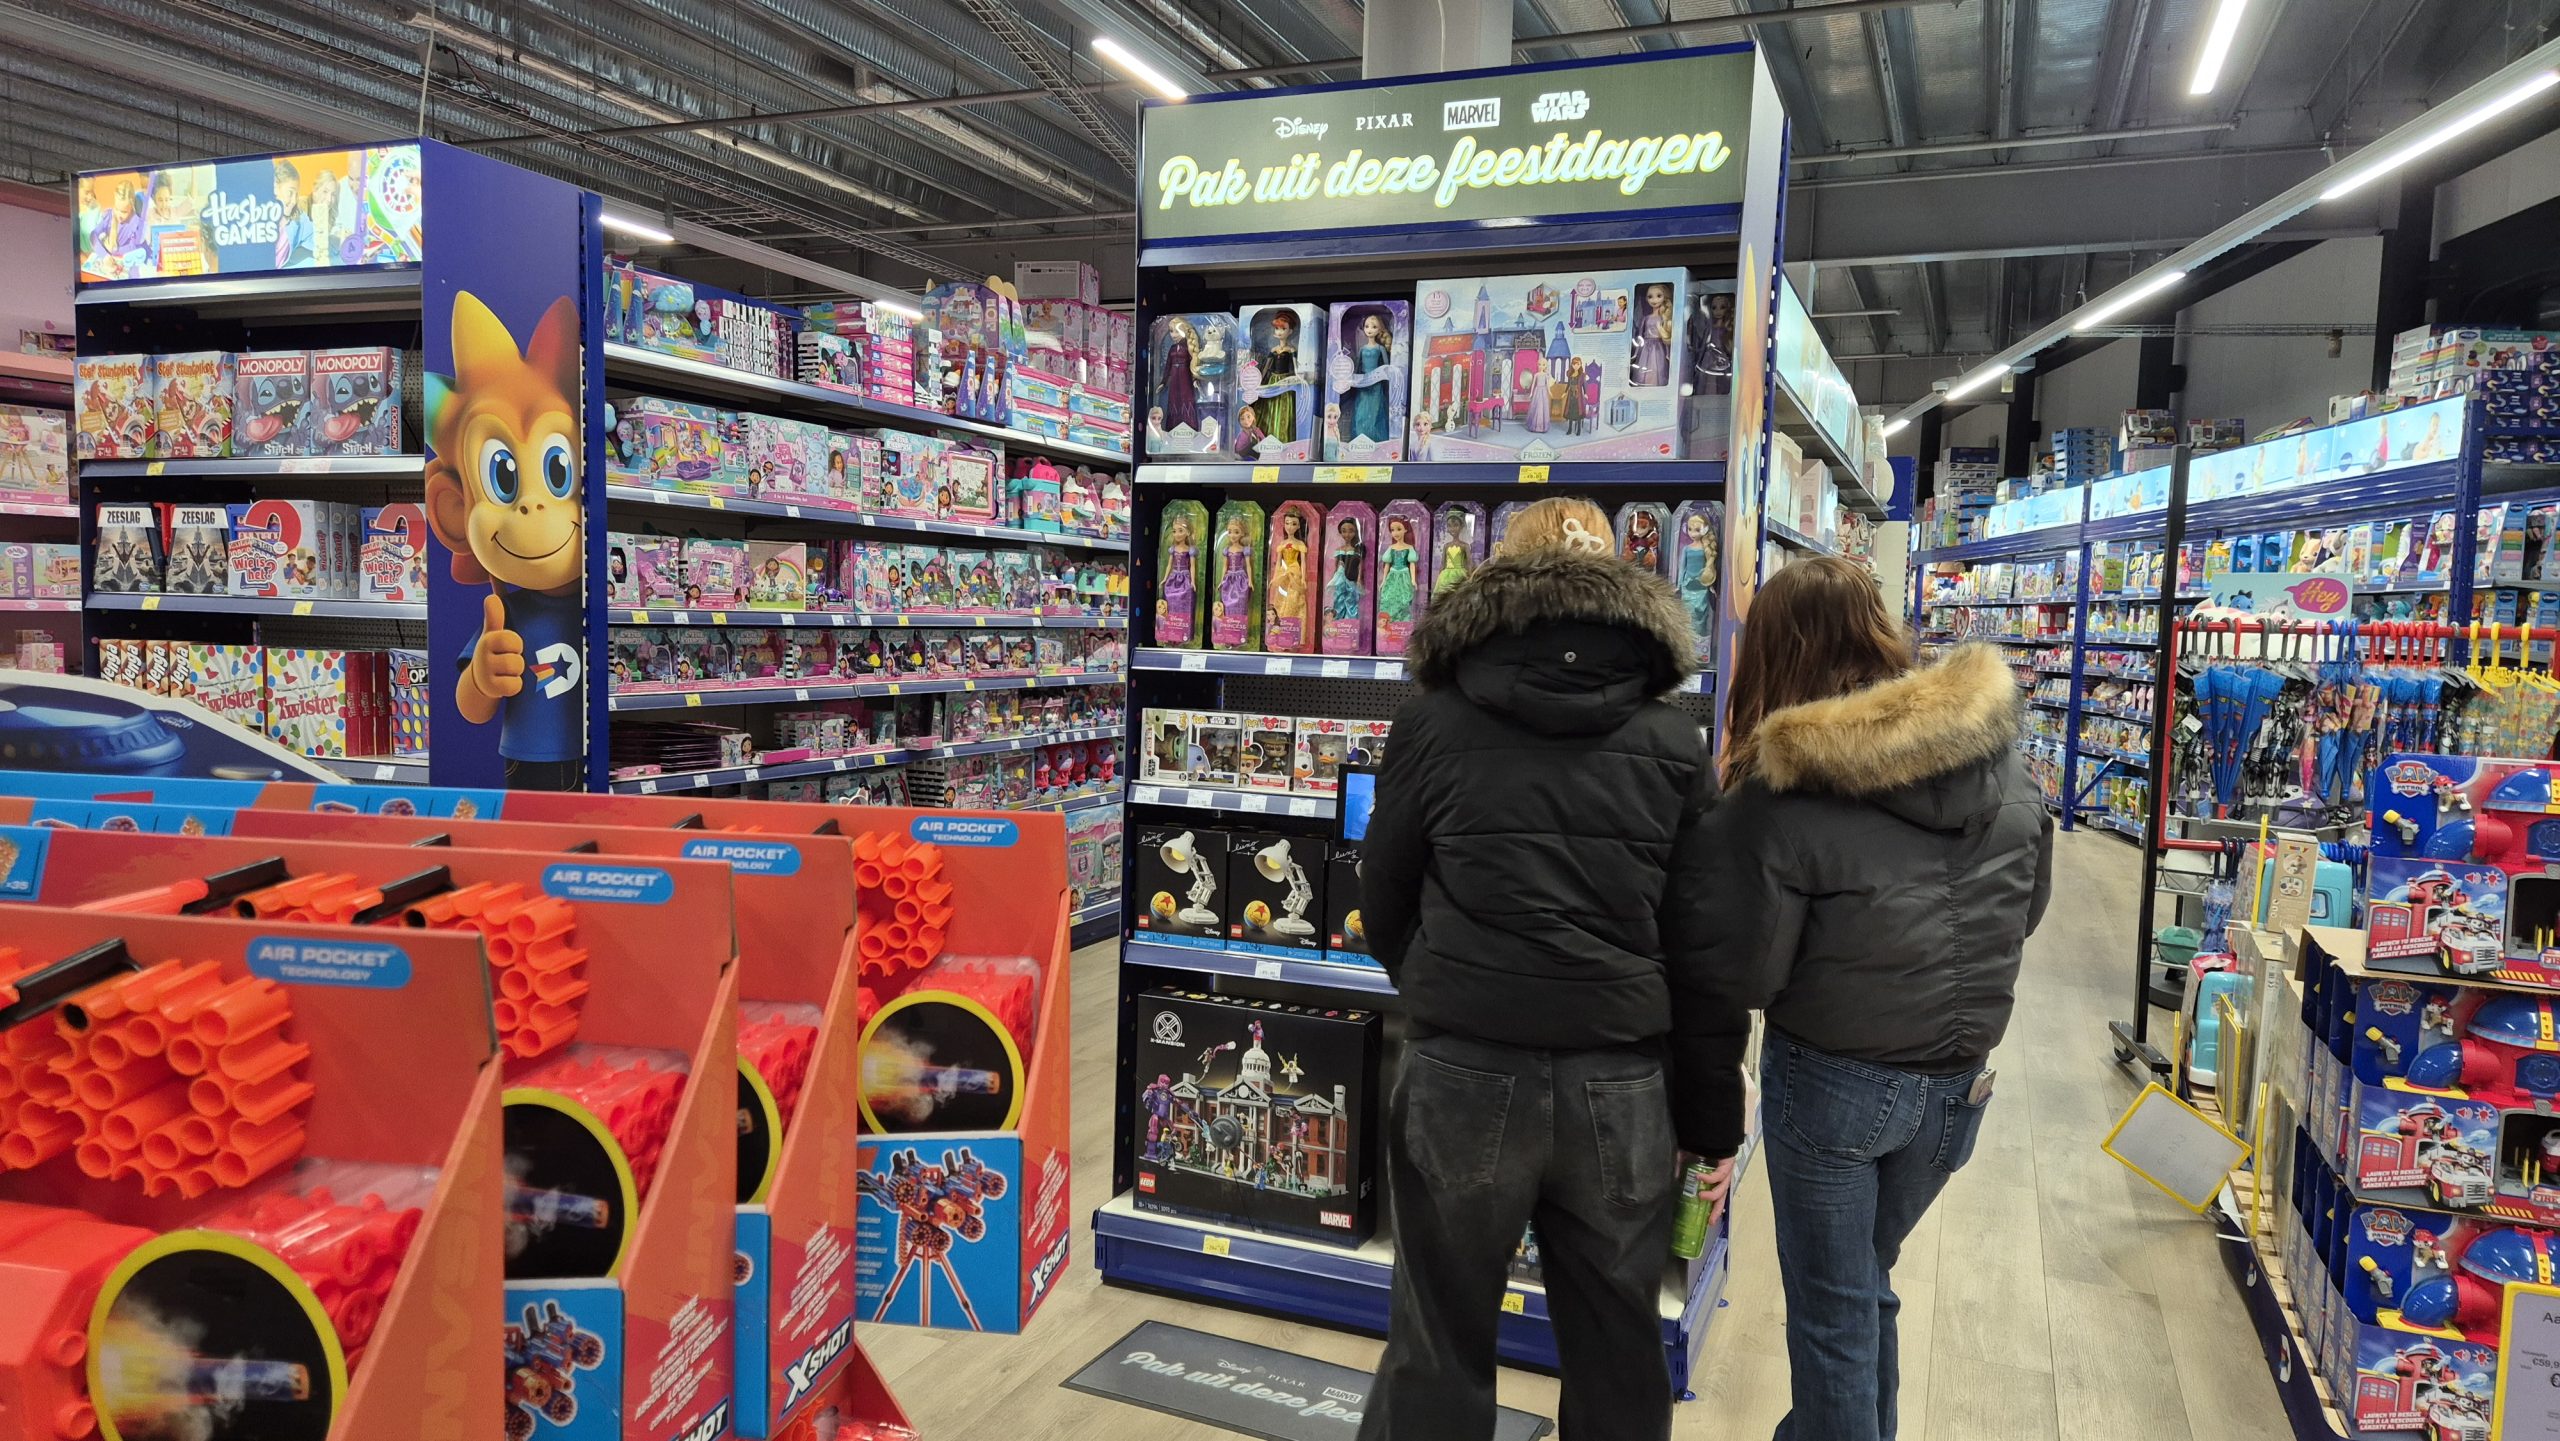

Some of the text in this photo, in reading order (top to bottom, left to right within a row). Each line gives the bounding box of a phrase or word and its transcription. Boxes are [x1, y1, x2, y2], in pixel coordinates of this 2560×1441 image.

[1538, 91, 1590, 108] STAR
[1355, 113, 1413, 131] PIXAR
[1447, 103, 1497, 126] MARVEL
[1531, 105, 1588, 123] WARS
[1272, 116, 1329, 140] Disney
[1158, 129, 1731, 210] Pak uit deze feestdagen
[208, 191, 283, 230] Hasbro
[214, 222, 279, 247] GAMES
[239, 359, 305, 376] MONOPOLY
[316, 355, 383, 374] MONOPOLY
[107, 511, 141, 525] ZEESLAG
[181, 511, 216, 525] ZEESLAG
[2299, 580, 2341, 612] Hey
[122, 645, 141, 687] Jenga
[147, 646, 168, 688] Jenga
[170, 647, 189, 689] Jenga
[396, 661, 411, 690] 4
[197, 688, 257, 713] Twister
[275, 692, 338, 720] Twister
[2386, 764, 2439, 786] PAW
[919, 822, 1006, 834] AIR POCKET
[932, 833, 994, 843] TECHNOLOGY
[691, 845, 788, 860] AIR POCKET
[551, 870, 658, 887] AIR POCKET
[568, 887, 642, 898] TECHNOLOGY
[259, 945, 393, 968] AIR POCKET
[280, 965, 372, 981] TECHNOLOGY
[2368, 981, 2421, 1004] PAW
[1321, 1211, 1351, 1228] MARVEL
[2361, 1211, 2414, 1234] PAW
[1122, 1351, 1308, 1412] Pak uit deze
[1268, 1373, 1306, 1388] PIXAR
[1326, 1388, 1361, 1403] MARVEL
